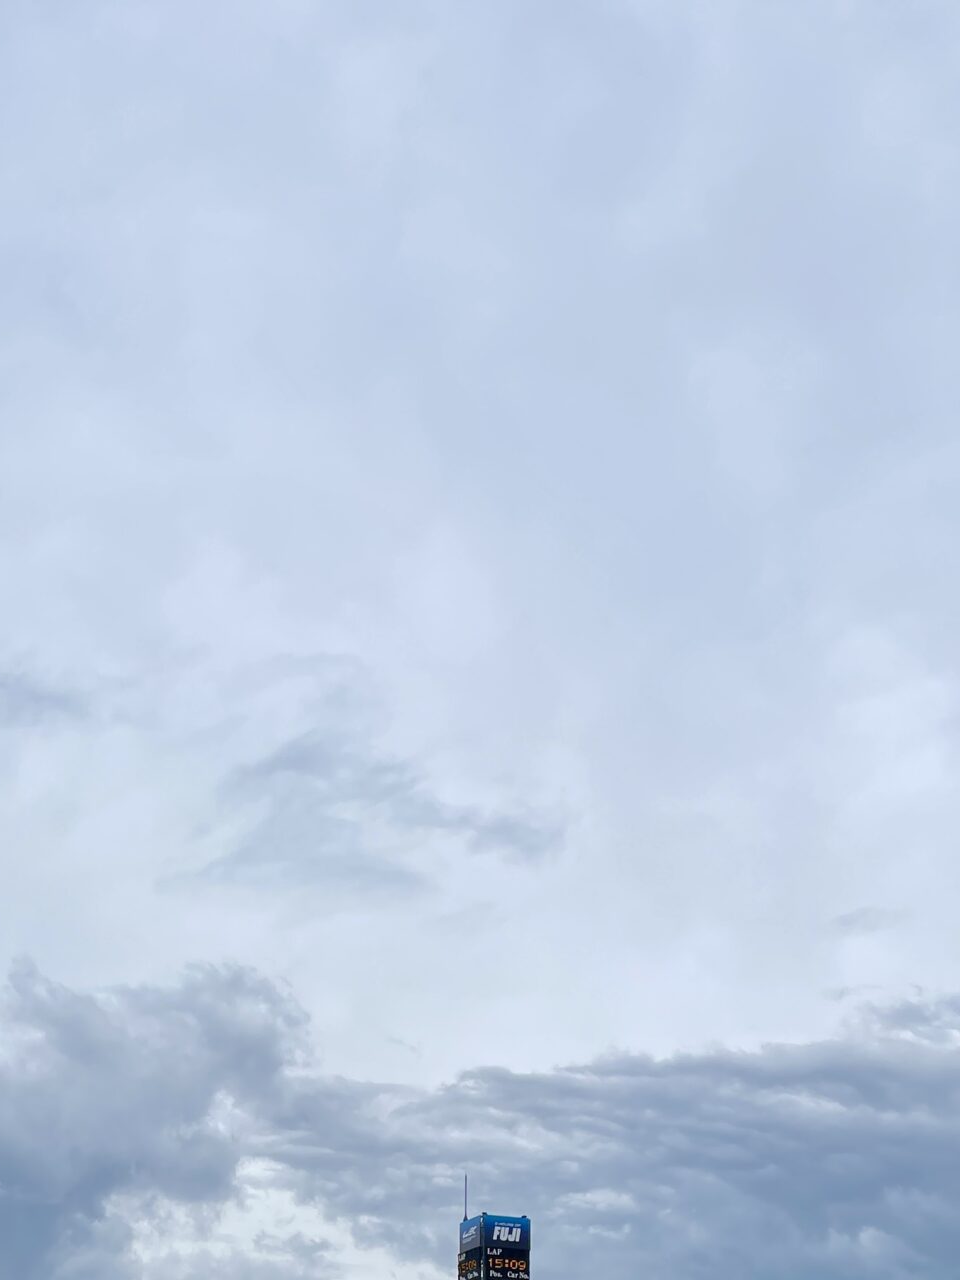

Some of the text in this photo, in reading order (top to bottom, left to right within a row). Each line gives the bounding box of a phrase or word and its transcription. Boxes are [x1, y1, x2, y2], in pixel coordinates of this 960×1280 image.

[492, 1226, 521, 1242] FUJI
[488, 1258, 527, 1270] 15:09
[489, 1270, 503, 1278] Pos.
[507, 1271, 519, 1279] Car
